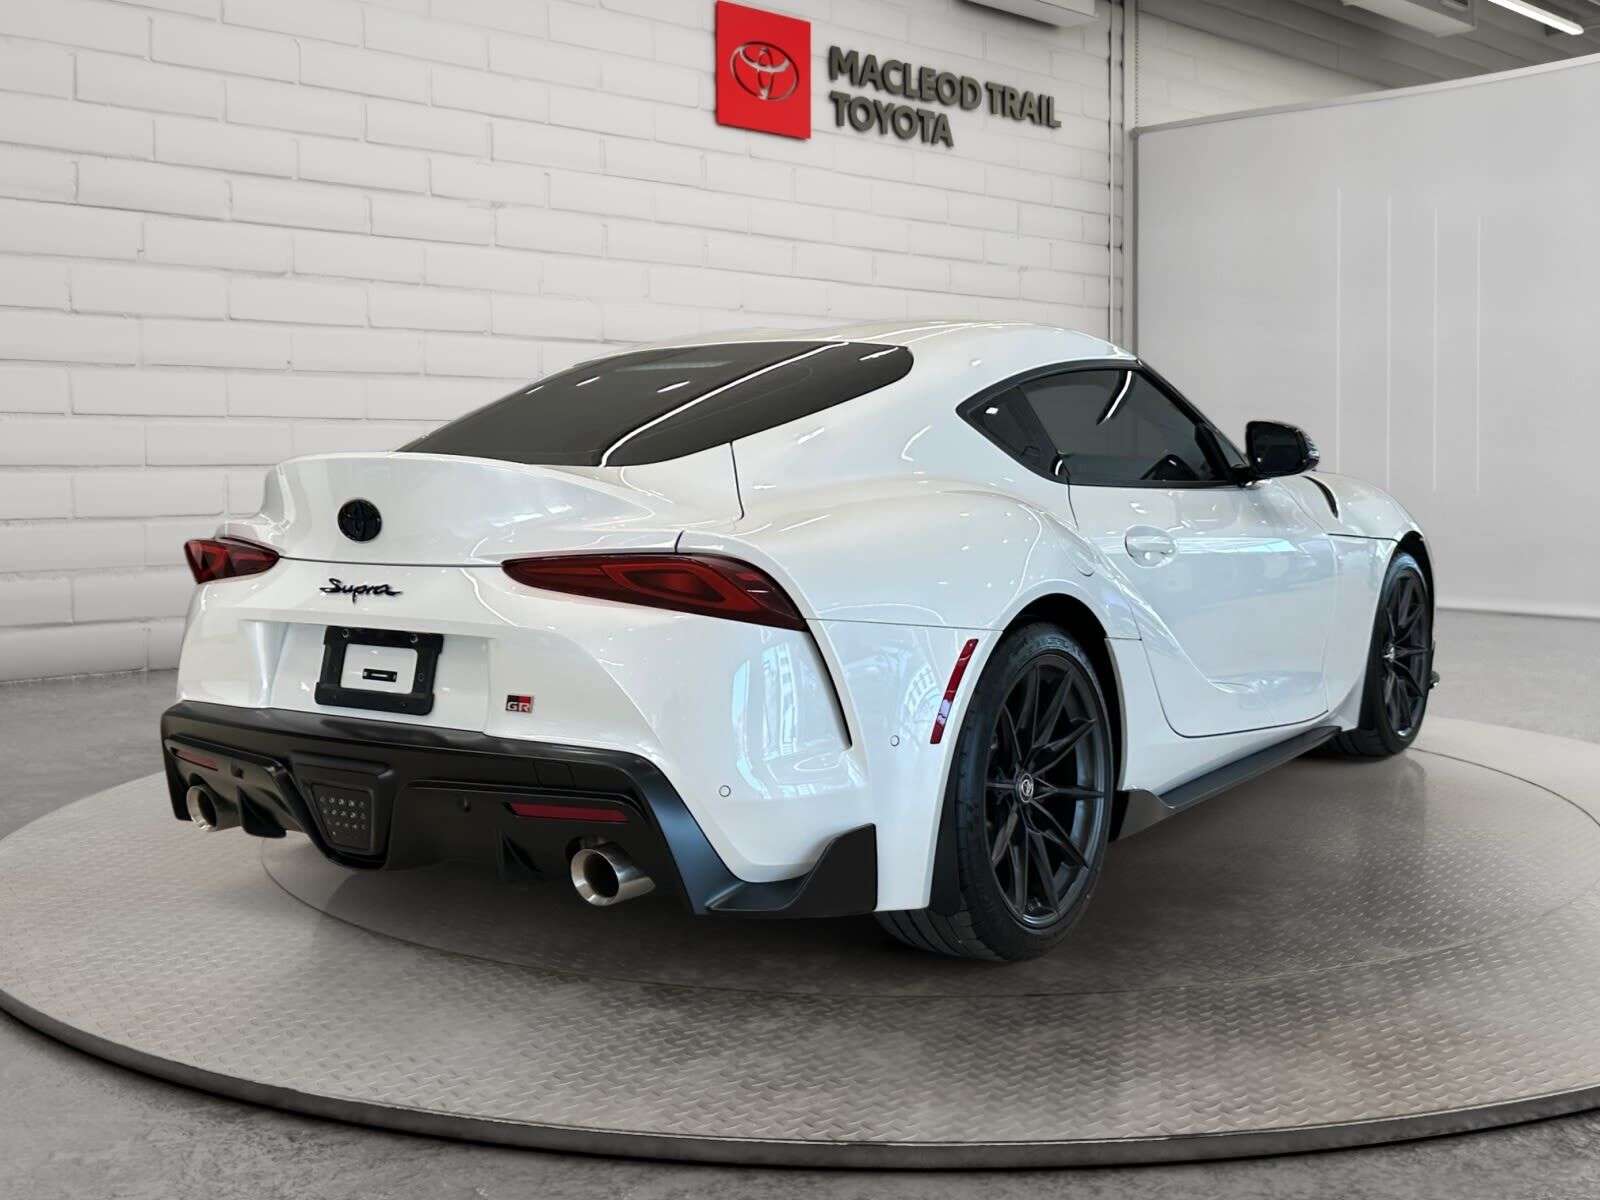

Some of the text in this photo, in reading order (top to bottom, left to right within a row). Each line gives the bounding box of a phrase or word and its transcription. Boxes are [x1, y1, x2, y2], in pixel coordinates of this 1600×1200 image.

[828, 45, 1062, 129] MACLEOD TRAIL
[829, 90, 954, 147] TOYOTA
[319, 578, 403, 604] Supra
[507, 701, 531, 712] GR
